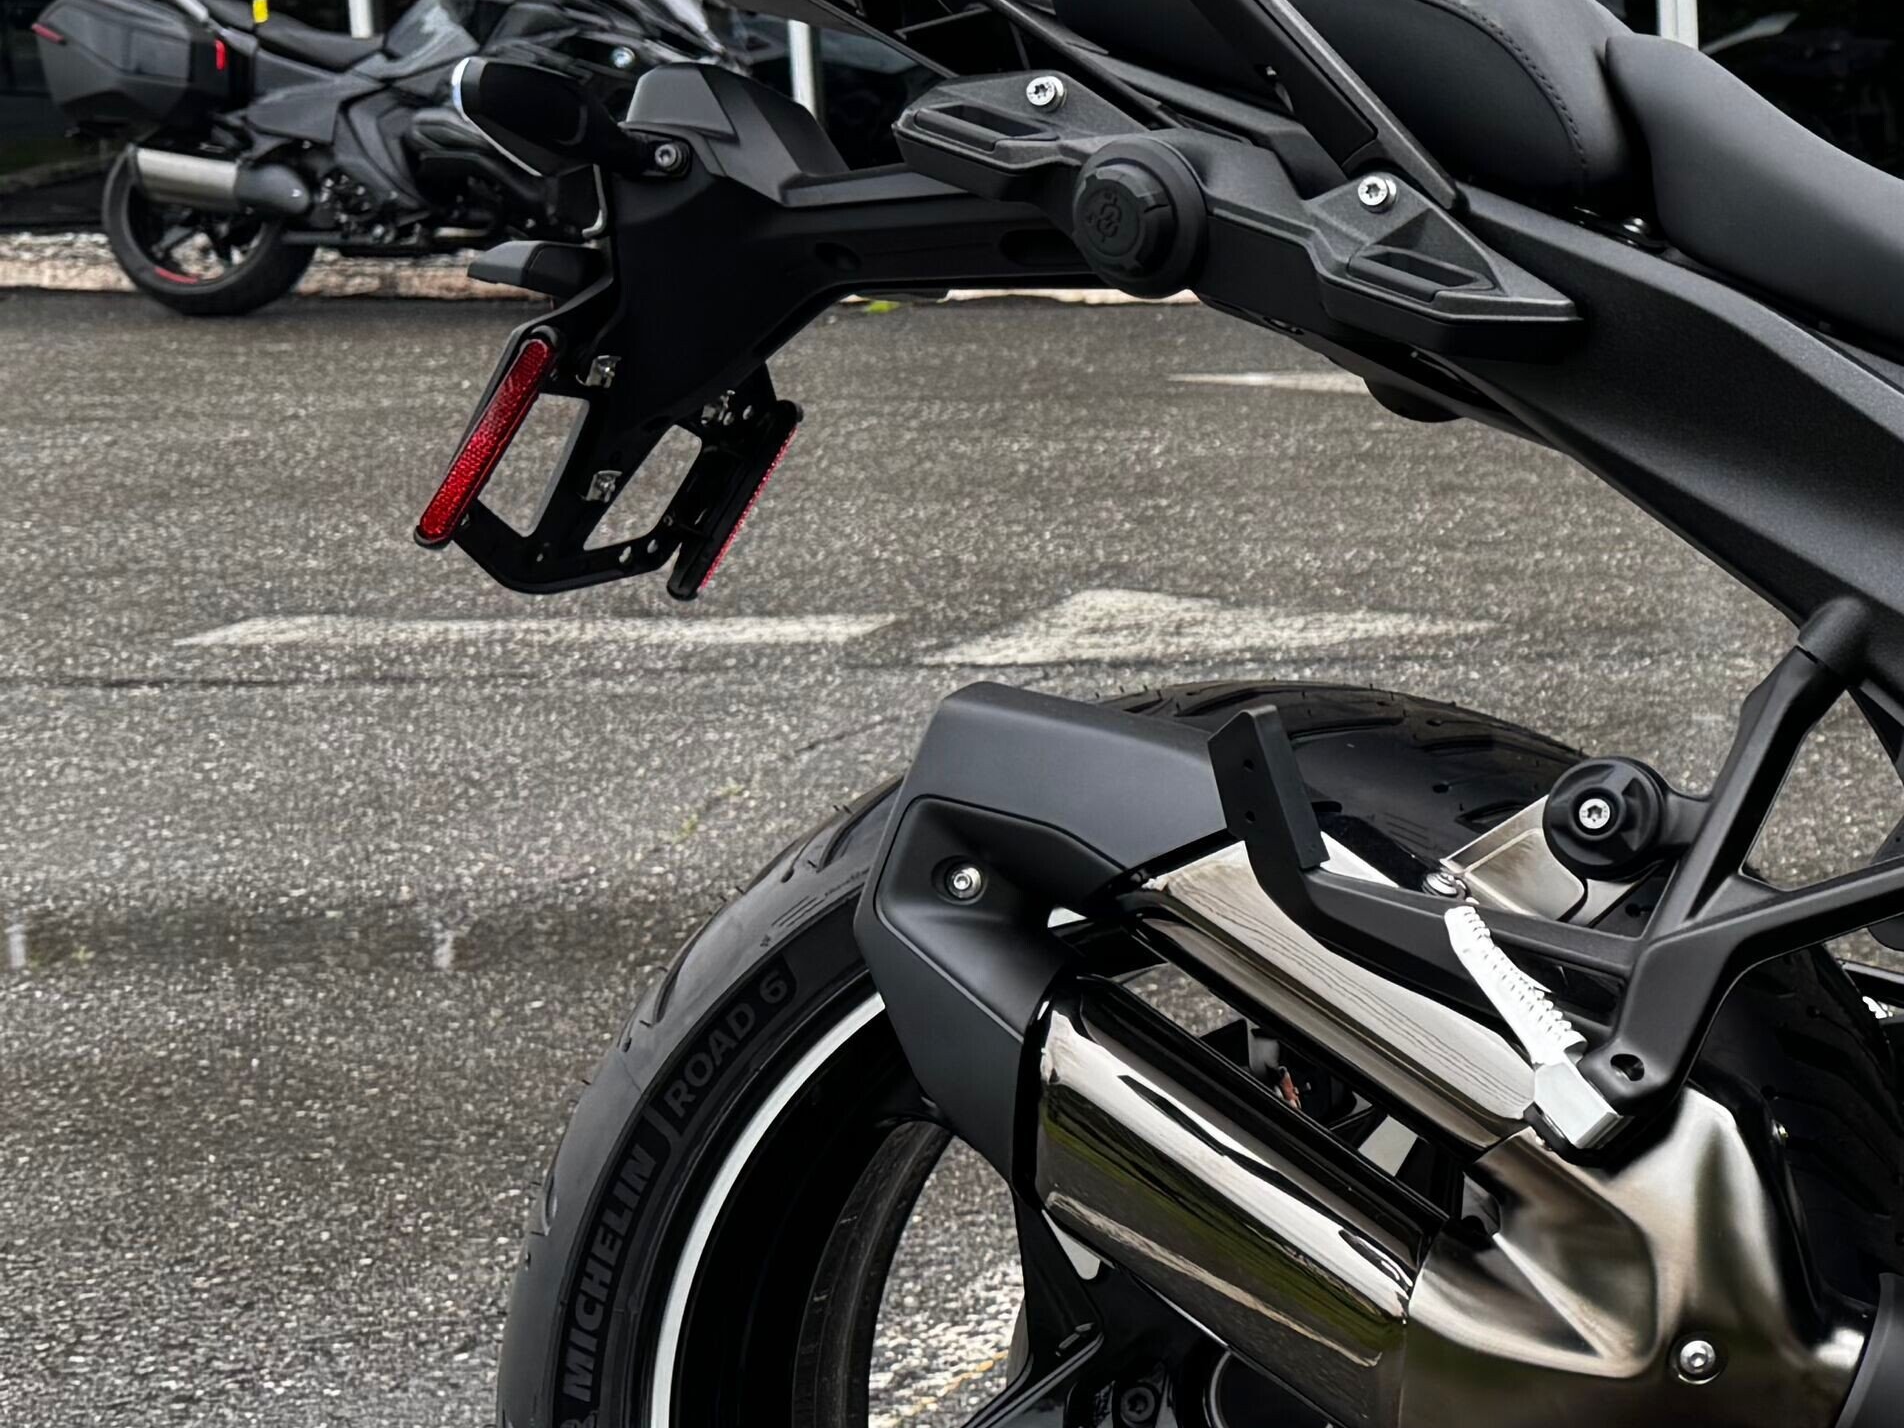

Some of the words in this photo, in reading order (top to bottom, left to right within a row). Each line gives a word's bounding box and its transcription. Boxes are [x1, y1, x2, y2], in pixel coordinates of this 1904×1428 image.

[562, 1142, 657, 1403] MICHELIN
[663, 1002, 757, 1119] ROAD
[758, 973, 789, 1005] 6
